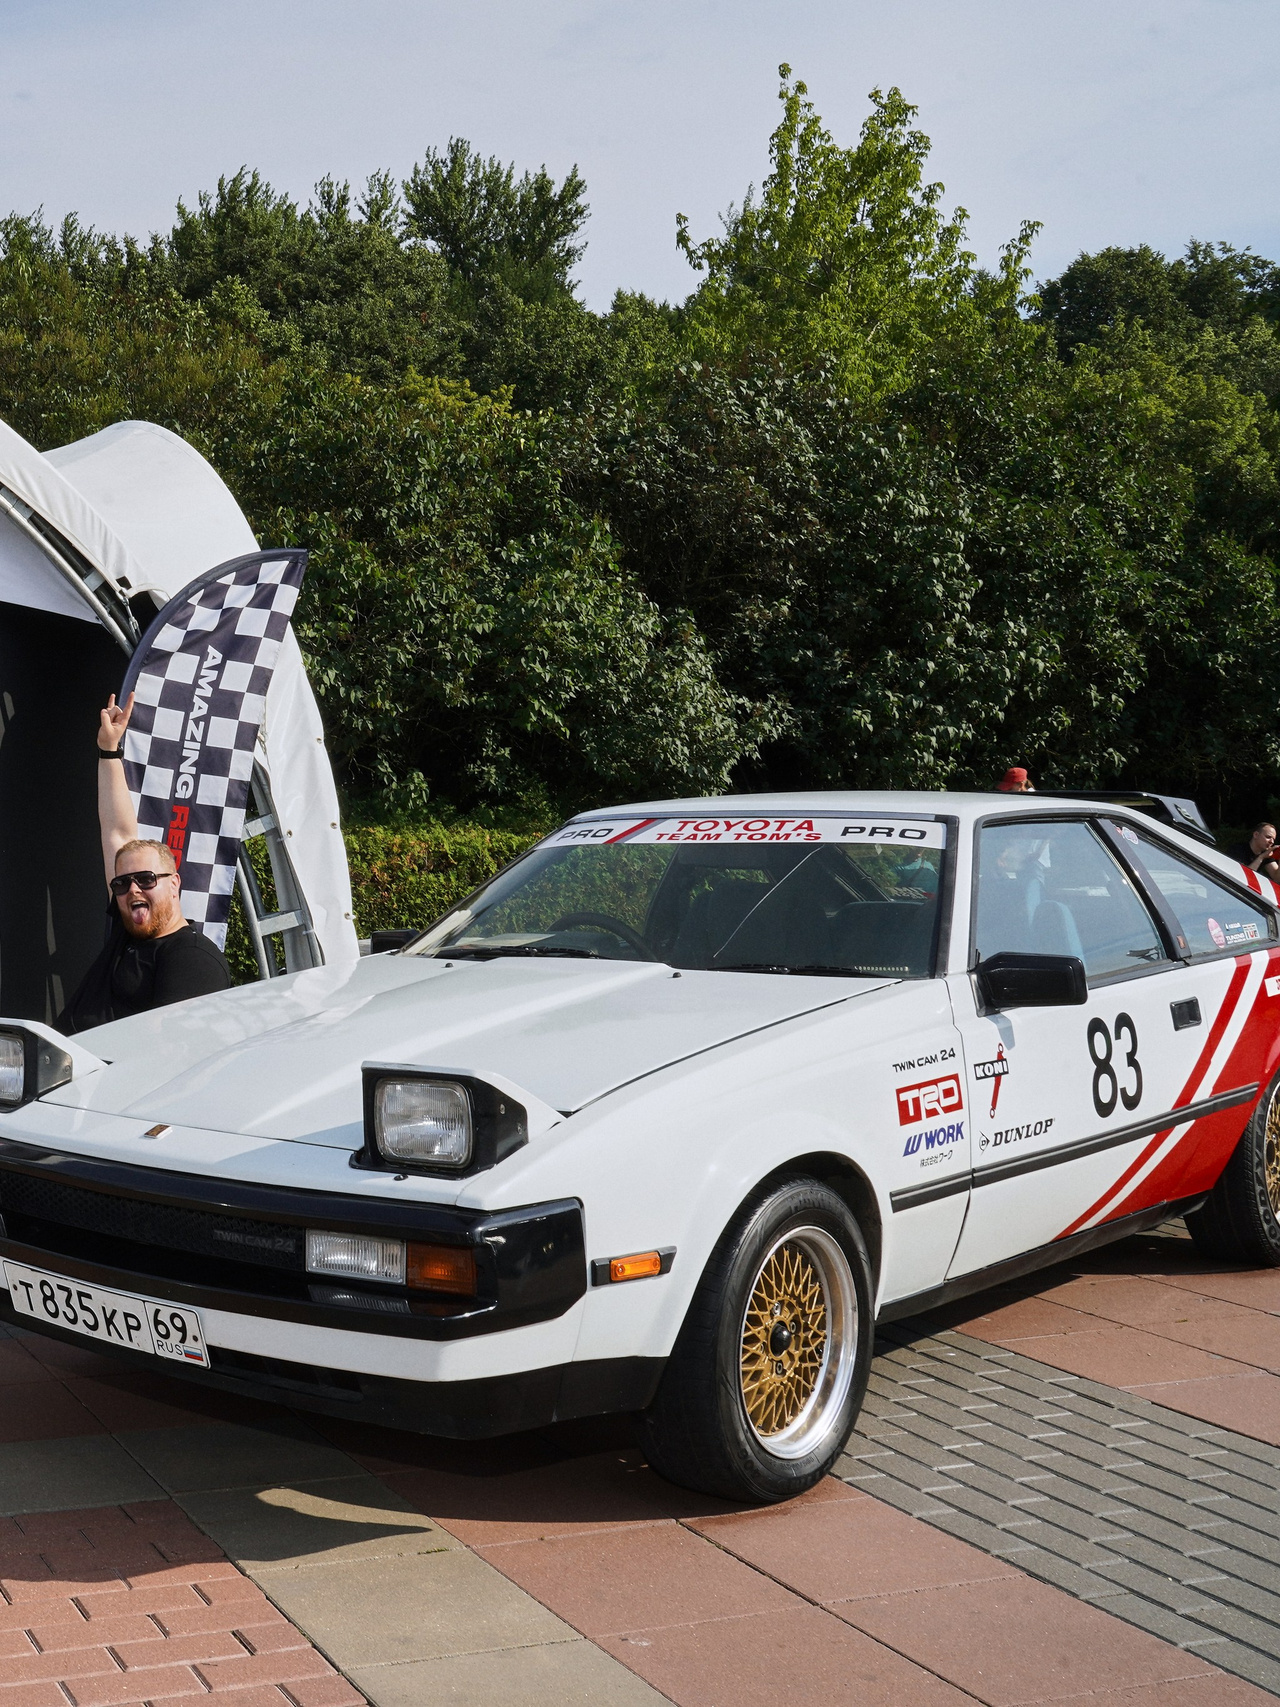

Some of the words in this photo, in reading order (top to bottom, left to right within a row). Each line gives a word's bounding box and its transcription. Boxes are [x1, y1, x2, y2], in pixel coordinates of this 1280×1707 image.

[174, 644, 223, 799] AMAZING
[557, 826, 615, 843] PRO
[654, 832, 726, 841] TEAM
[732, 831, 824, 841] TOM'S
[676, 818, 816, 832] TOYOTA
[841, 825, 928, 841] PRO
[892, 1059, 916, 1073] TWIN
[917, 1053, 939, 1067] CAM
[940, 1047, 956, 1061] 24
[975, 1060, 1008, 1078] KONI
[1086, 1011, 1144, 1118] 83
[897, 1077, 960, 1120] TRD
[924, 1121, 965, 1150] WORK
[991, 1118, 1054, 1148] DUNLOP
[213, 1229, 243, 1242] TWIN
[245, 1235, 272, 1249] CAM
[274, 1238, 296, 1253] 24
[152, 1308, 188, 1345] 69
[156, 1339, 183, 1356] RUS
